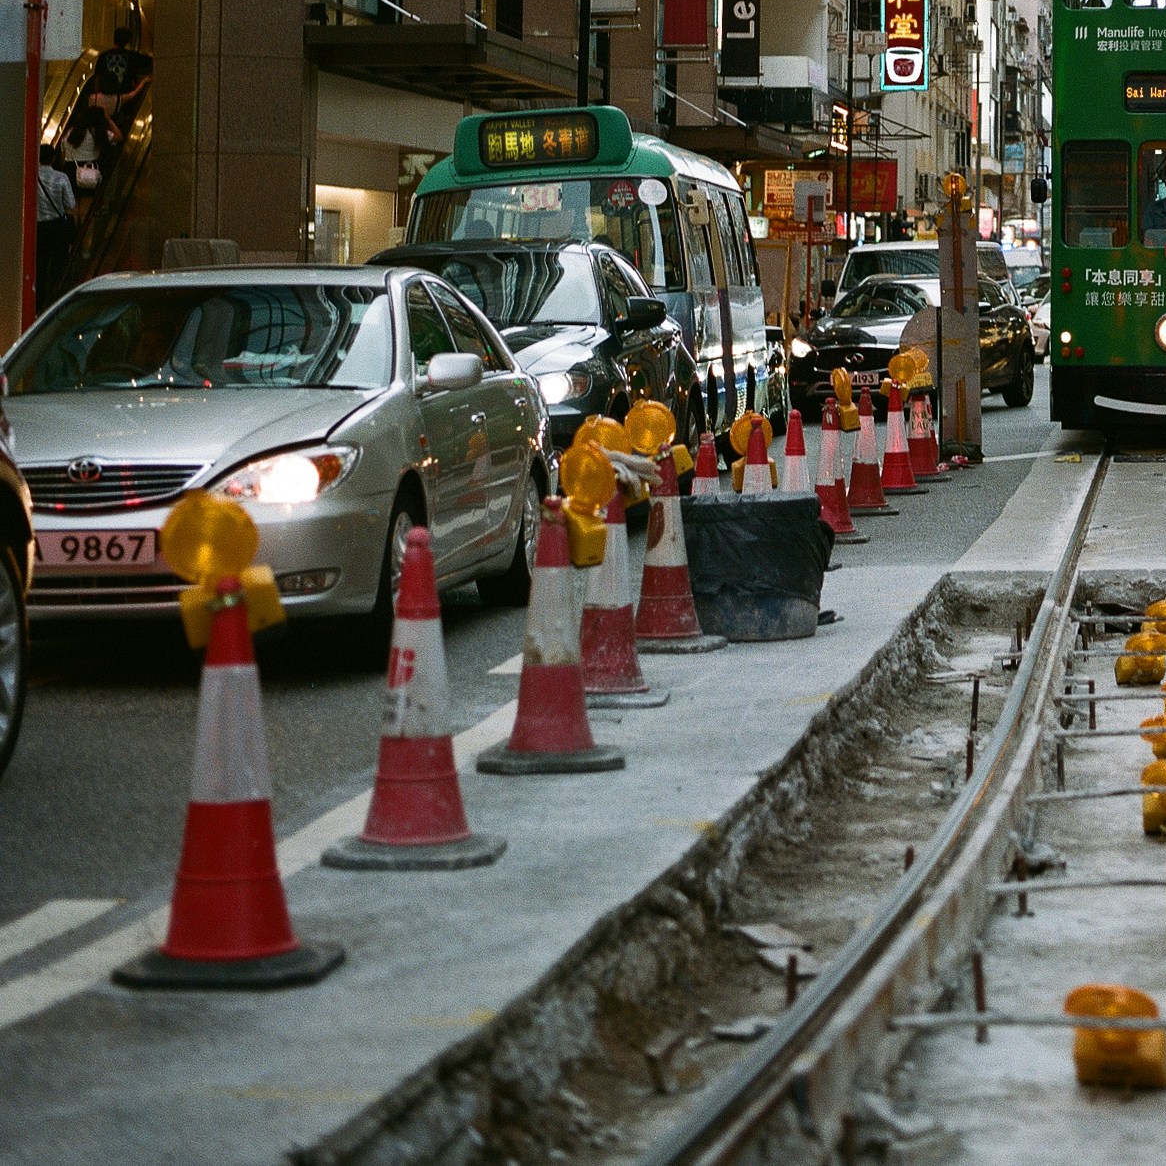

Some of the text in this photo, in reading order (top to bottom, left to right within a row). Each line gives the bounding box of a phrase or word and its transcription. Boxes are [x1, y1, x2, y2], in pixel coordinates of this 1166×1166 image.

[1097, 26, 1144, 38] Manulife
[1097, 40, 1163, 51] 宏利投資管理
[1126, 87, 1144, 98] Sai
[511, 118, 536, 129] VALLEY
[487, 130, 536, 162] 跑馬地
[521, 184, 559, 211] 30
[61, 535, 147, 561] 9867
